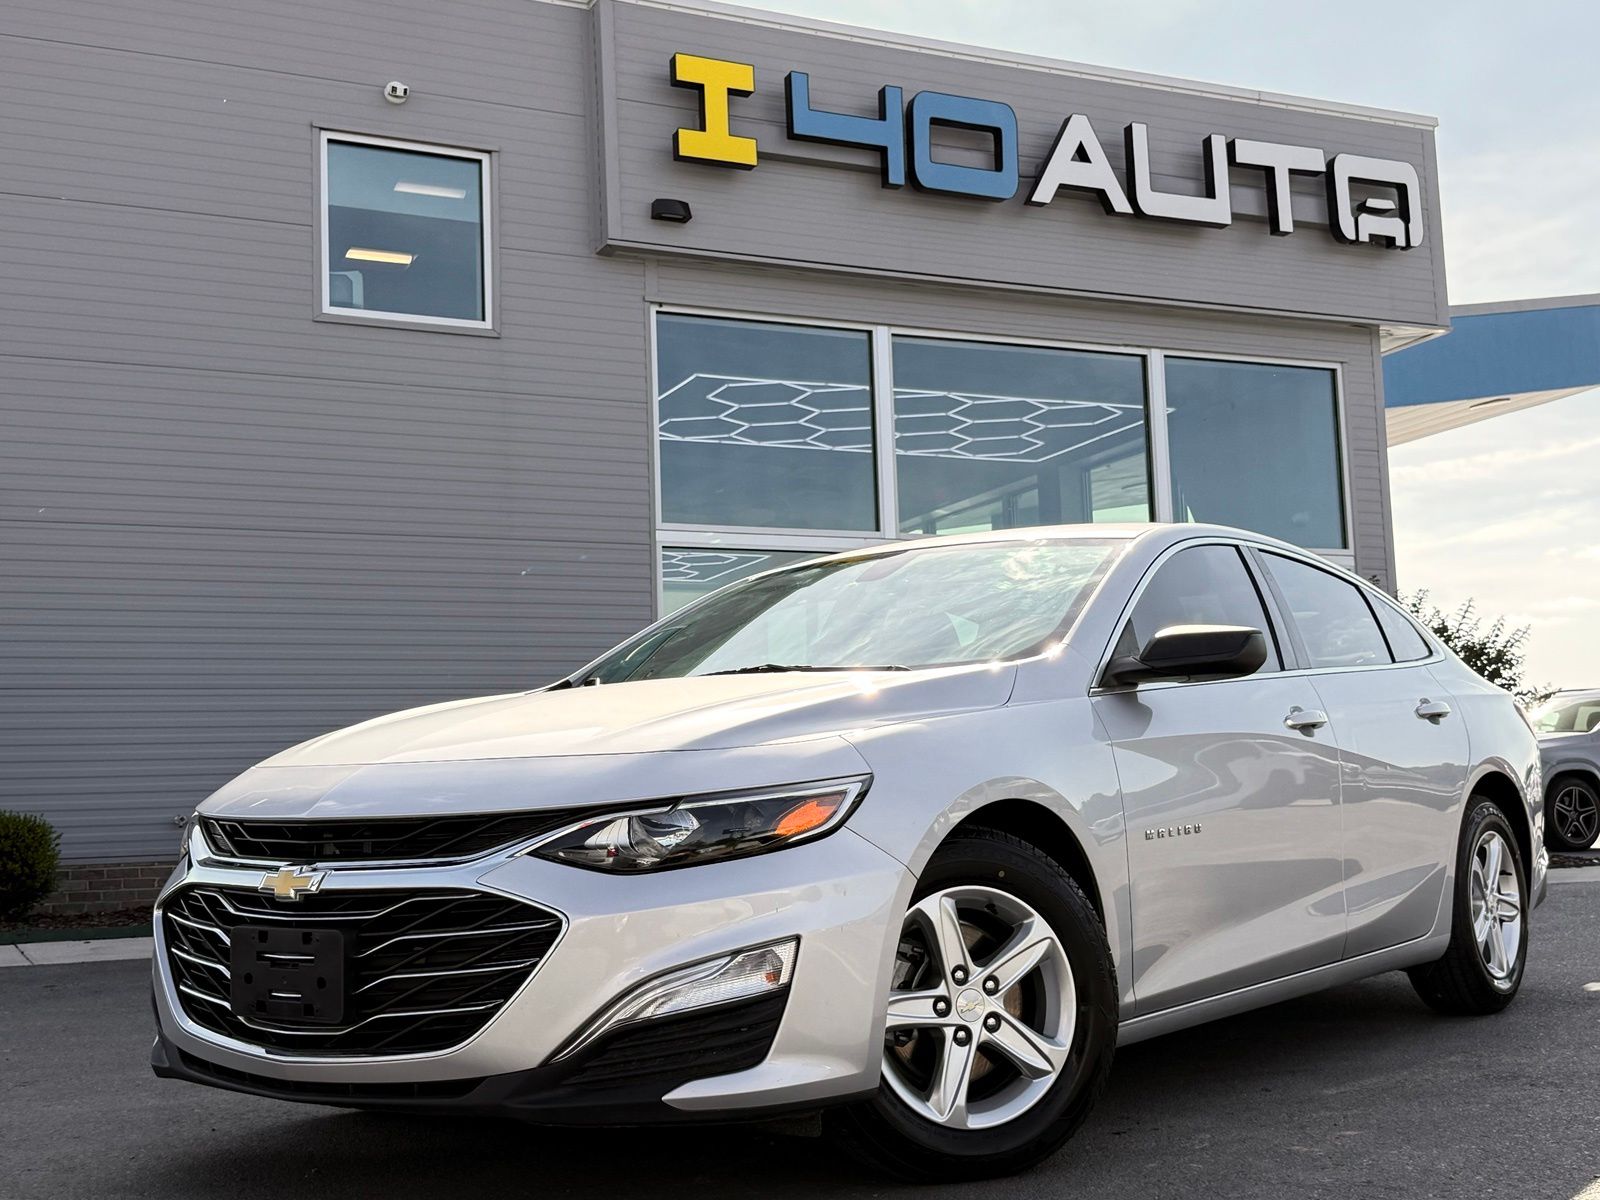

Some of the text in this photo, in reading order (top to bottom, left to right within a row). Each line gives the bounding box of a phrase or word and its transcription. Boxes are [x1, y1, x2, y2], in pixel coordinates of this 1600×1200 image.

[671, 53, 758, 170] I
[785, 71, 1019, 202] 40
[1145, 823, 1202, 840] MALIBU
